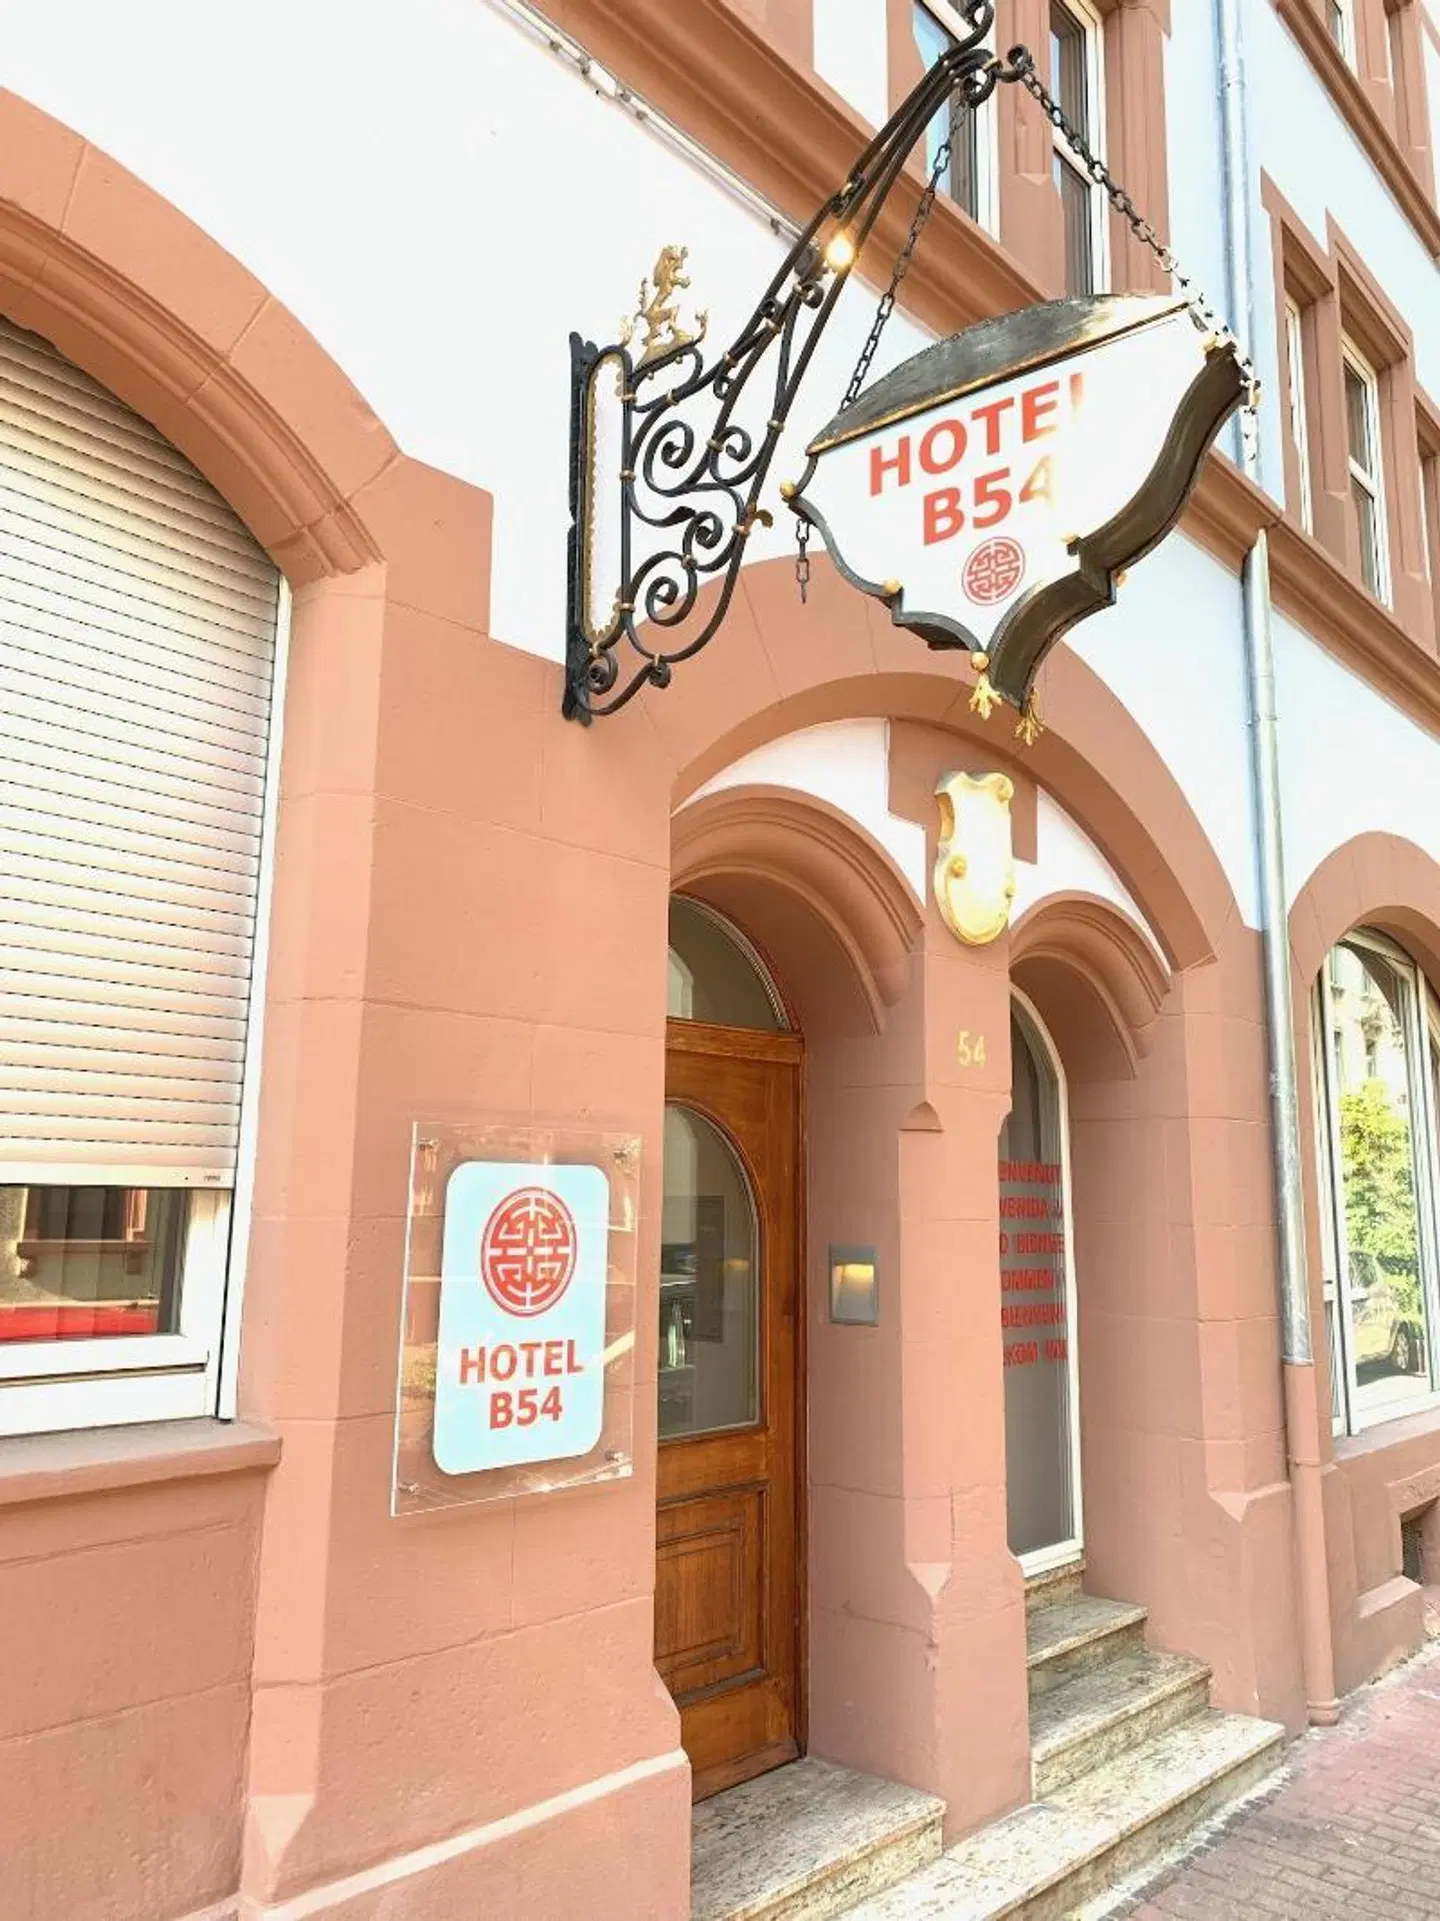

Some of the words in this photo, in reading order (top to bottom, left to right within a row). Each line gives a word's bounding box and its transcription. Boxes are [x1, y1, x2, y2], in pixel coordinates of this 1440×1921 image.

[922, 454, 1059, 546] B54
[957, 1030, 987, 1068] 54
[460, 1339, 585, 1385] HOTEL
[489, 1386, 563, 1430] B54
